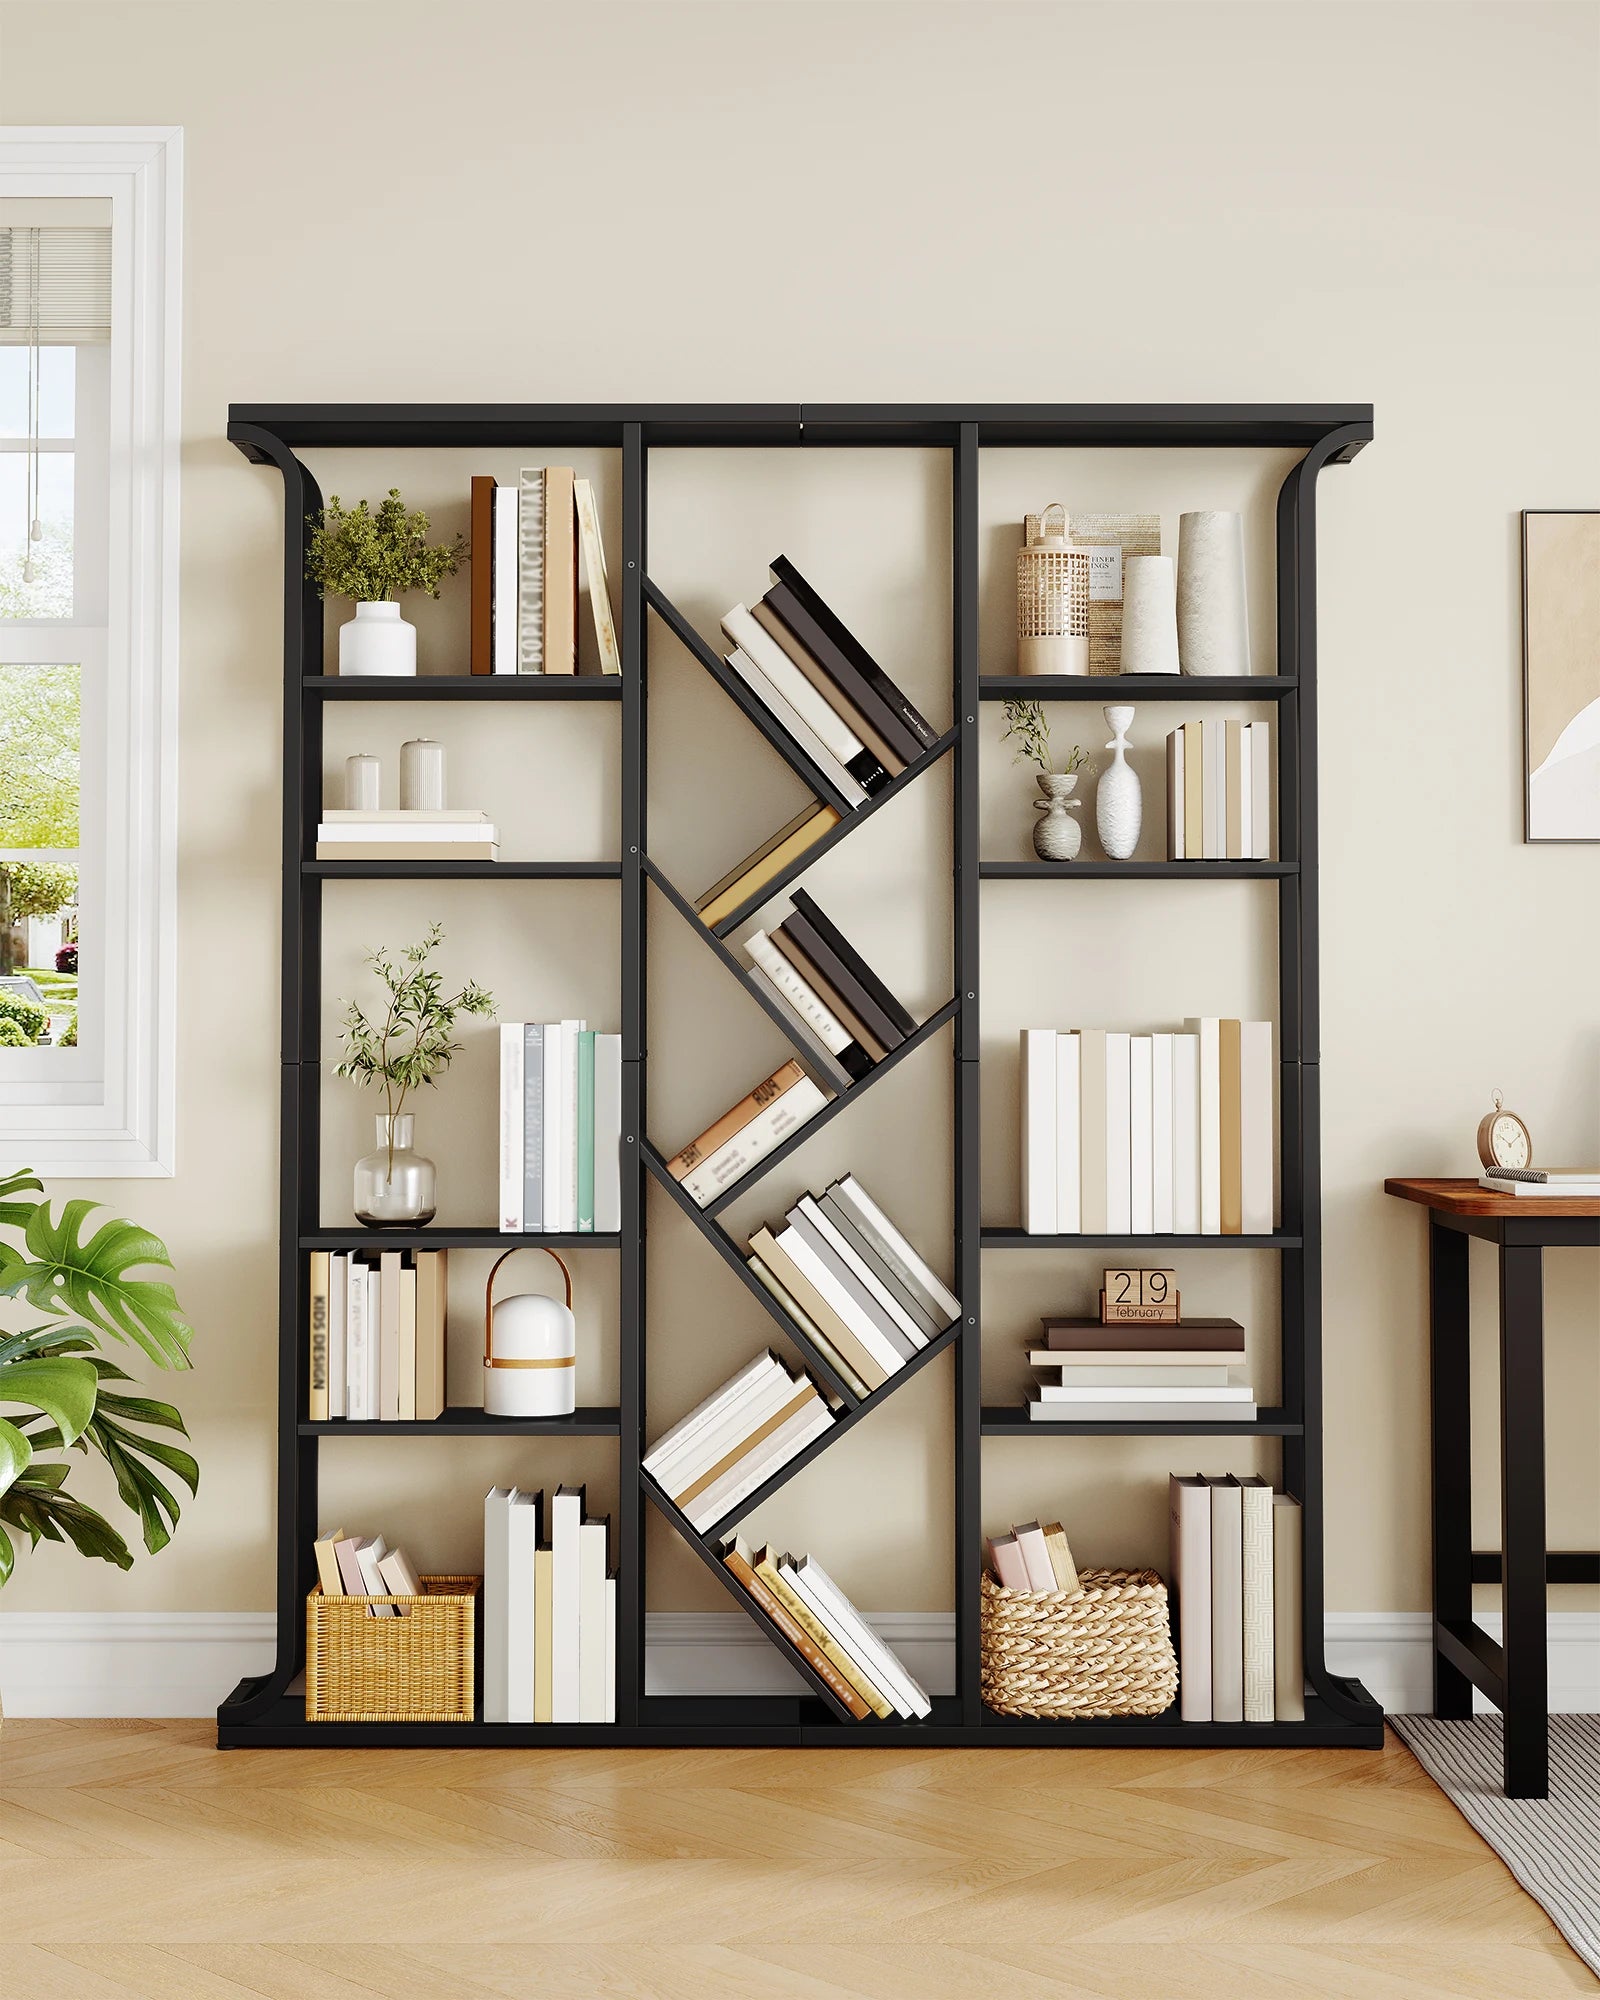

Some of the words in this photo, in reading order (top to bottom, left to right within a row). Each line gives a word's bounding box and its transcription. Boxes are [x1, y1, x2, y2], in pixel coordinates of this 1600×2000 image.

[312, 1295, 326, 1329] KIDS
[1116, 1305, 1165, 1320] february
[312, 1333, 326, 1390] DESIGN
